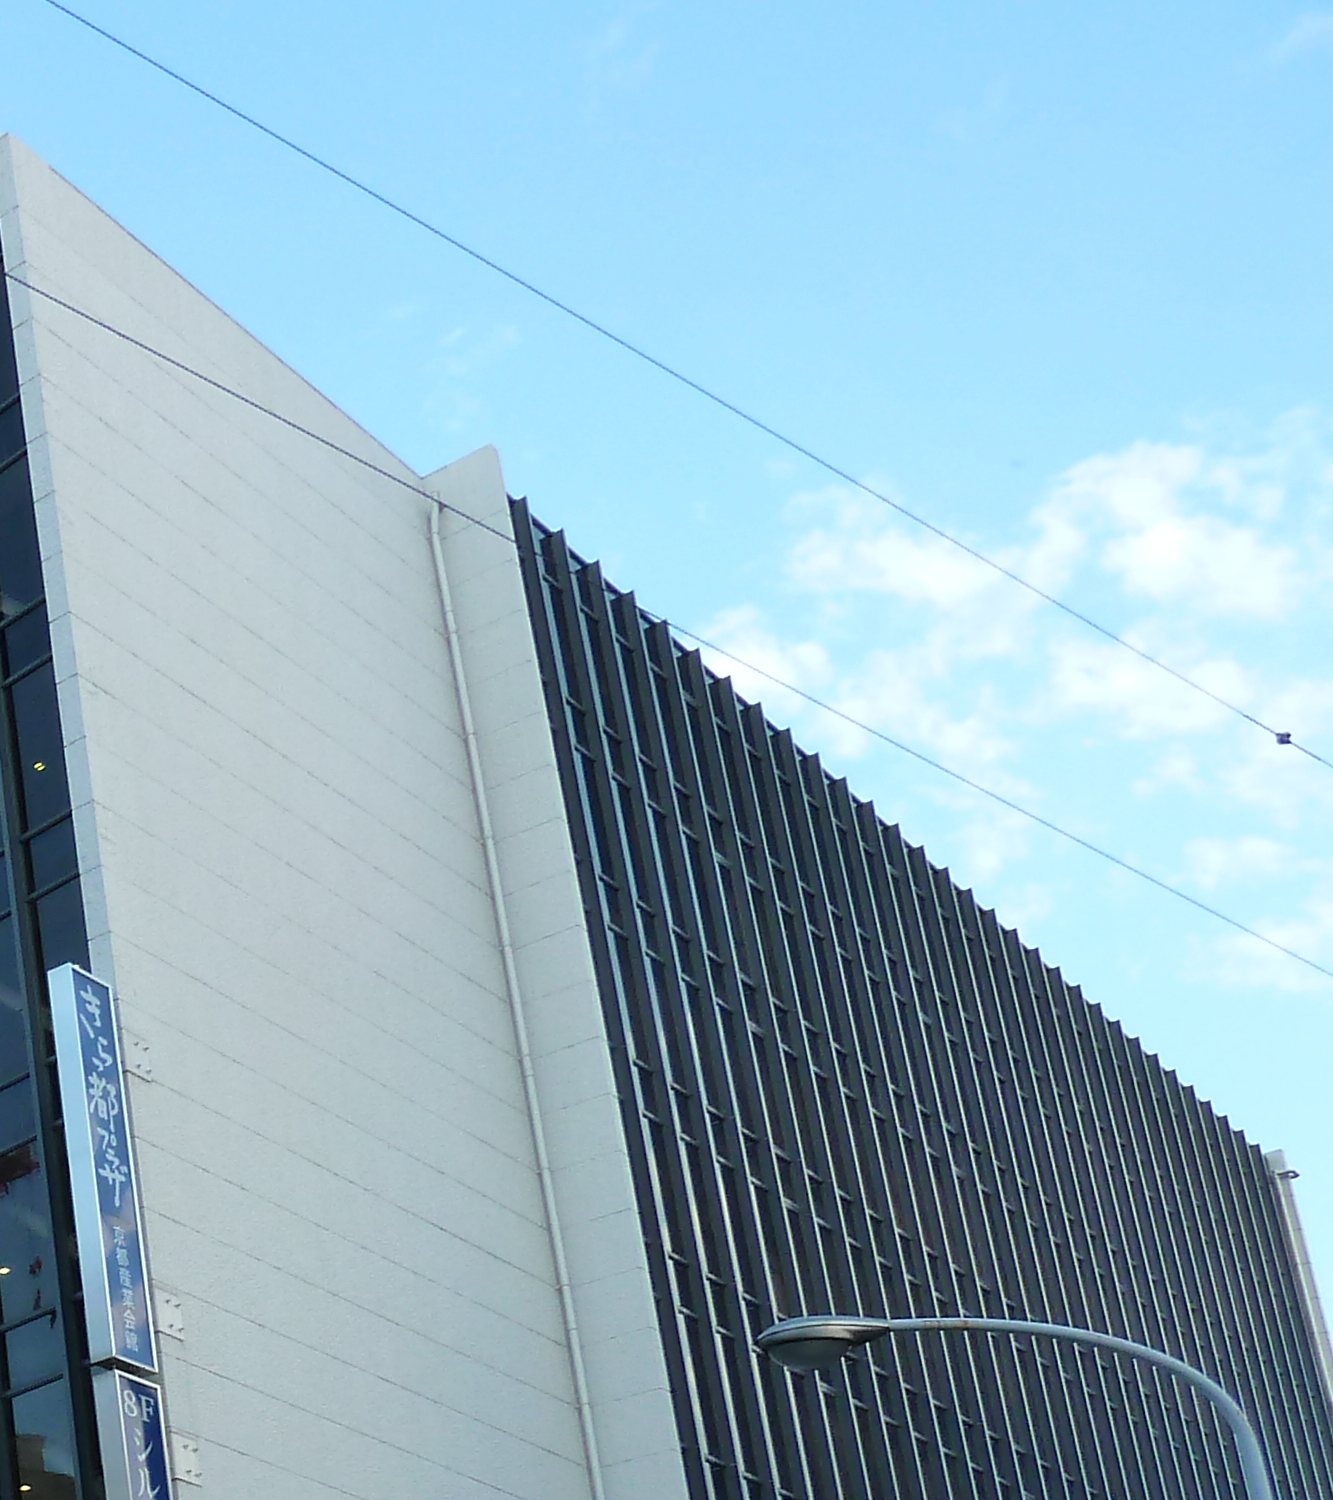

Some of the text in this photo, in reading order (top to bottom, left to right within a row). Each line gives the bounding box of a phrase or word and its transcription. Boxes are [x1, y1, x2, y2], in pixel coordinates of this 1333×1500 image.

[112, 1225, 139, 1353] 京都産業会館
[123, 1389, 155, 1423] 8F
